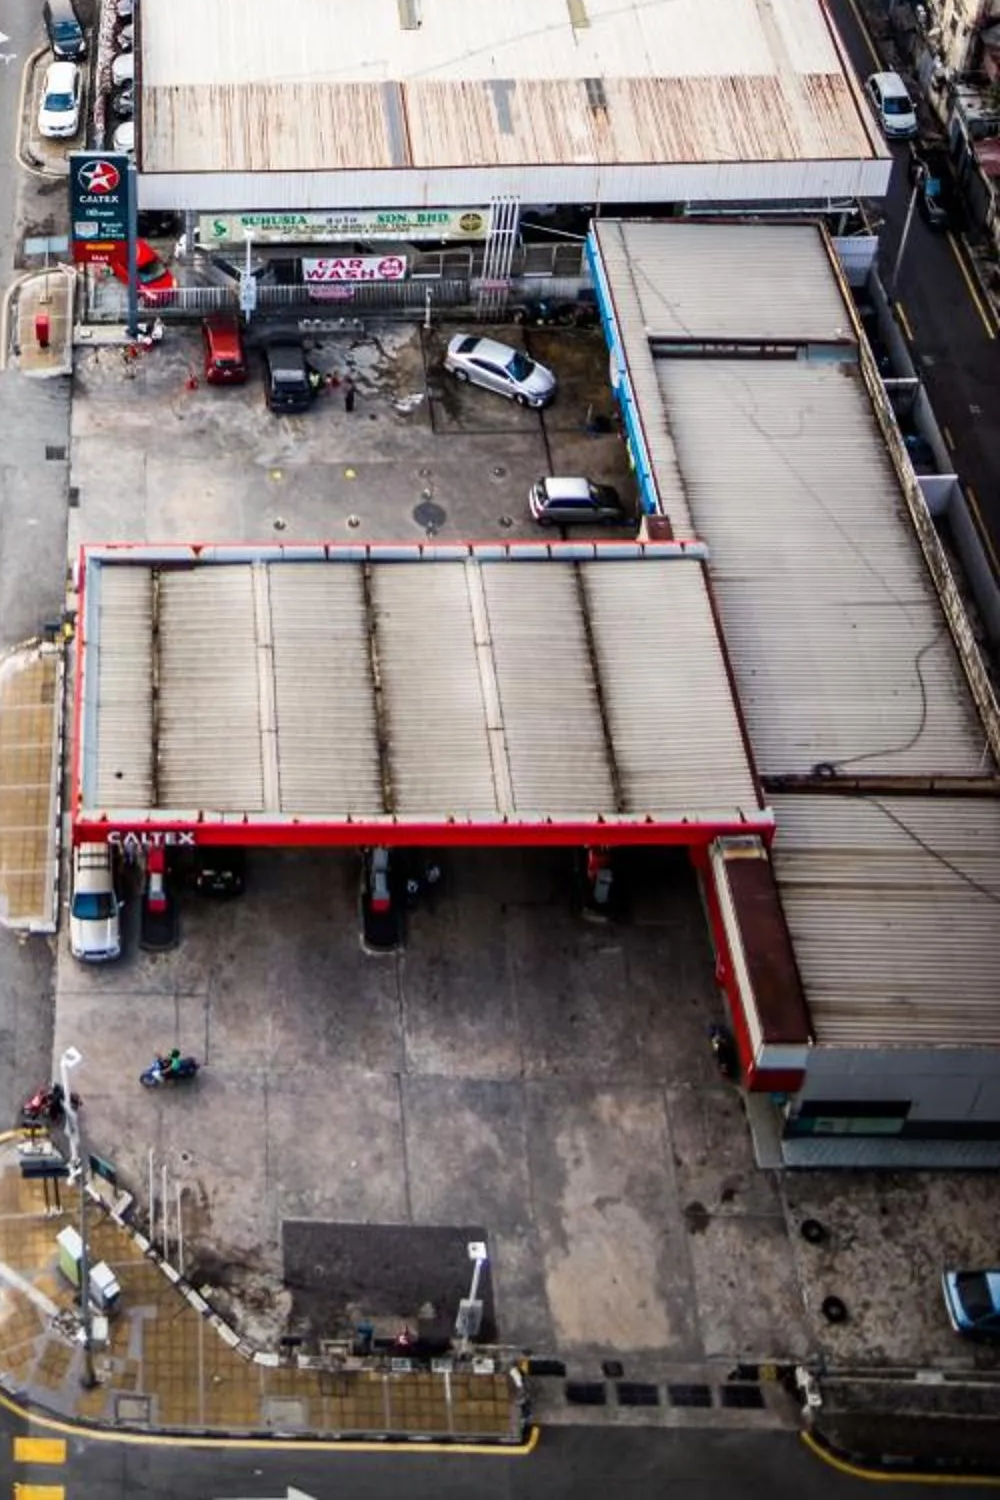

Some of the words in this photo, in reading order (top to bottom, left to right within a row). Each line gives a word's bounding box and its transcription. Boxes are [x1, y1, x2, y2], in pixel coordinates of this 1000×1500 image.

[80, 195, 119, 203] CALTEX
[317, 259, 363, 269] CAR
[305, 269, 375, 279] WASH
[107, 831, 196, 847] CALTEX
